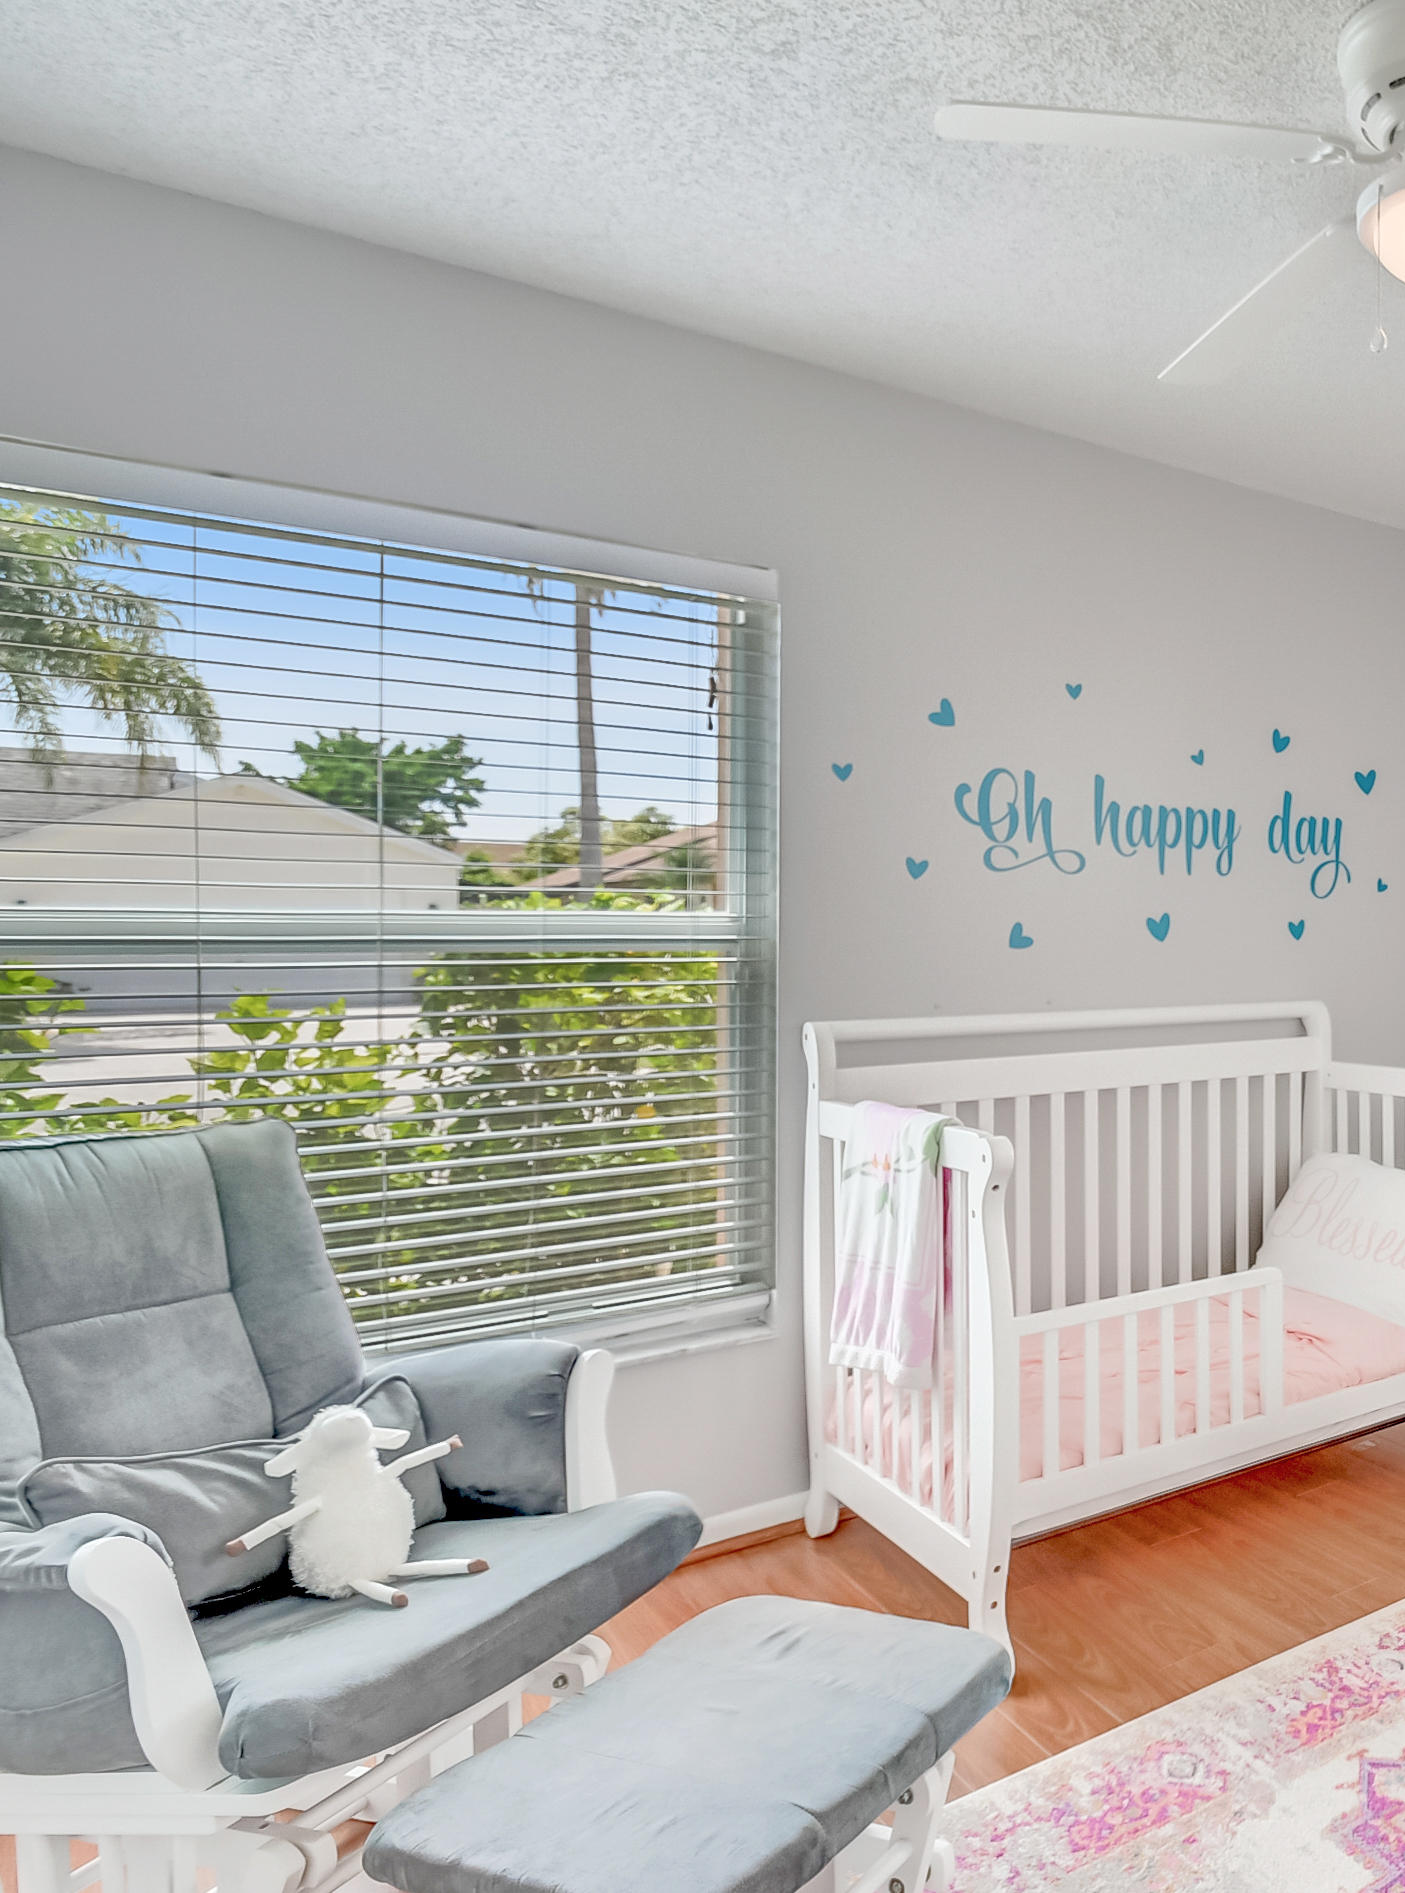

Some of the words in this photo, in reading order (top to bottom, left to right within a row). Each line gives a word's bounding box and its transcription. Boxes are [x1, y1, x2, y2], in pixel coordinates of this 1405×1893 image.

[954, 767, 1086, 876] Oh
[1094, 774, 1241, 876] happy
[1267, 790, 1352, 900] day
